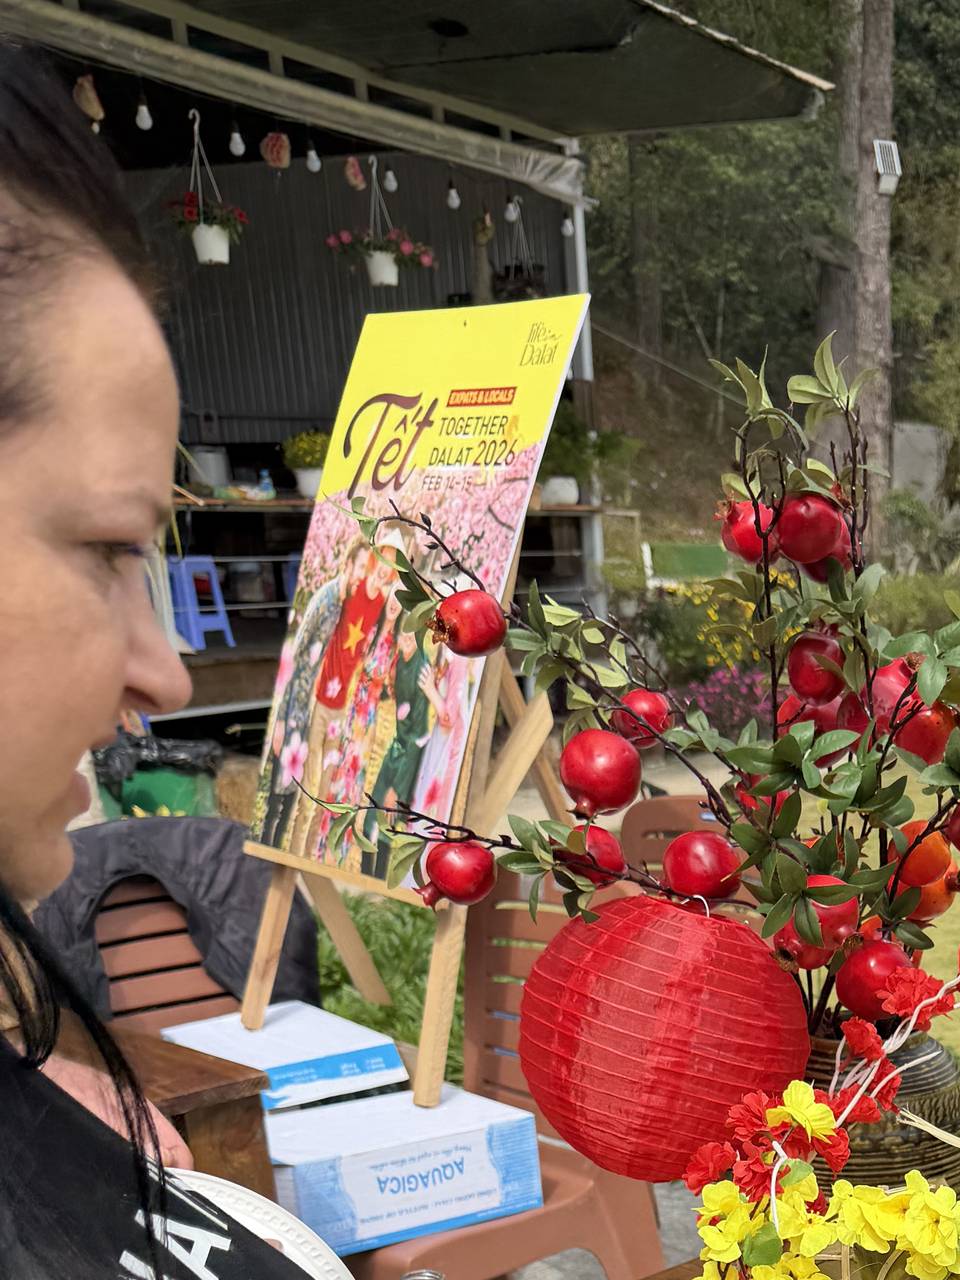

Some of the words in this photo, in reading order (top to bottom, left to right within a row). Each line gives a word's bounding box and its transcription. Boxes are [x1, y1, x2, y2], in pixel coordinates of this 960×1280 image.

[519, 342, 559, 366] Dalat
[448, 391, 479, 406] EXPATS
[484, 388, 515, 404] LOCALS
[438, 415, 509, 437] TOGETHER
[343, 392, 438, 500] Tết
[428, 446, 473, 467] DALAT
[472, 438, 518, 467] 2026
[422, 474, 443, 491] FEB
[376, 1156, 465, 1195] AQUAGICA
